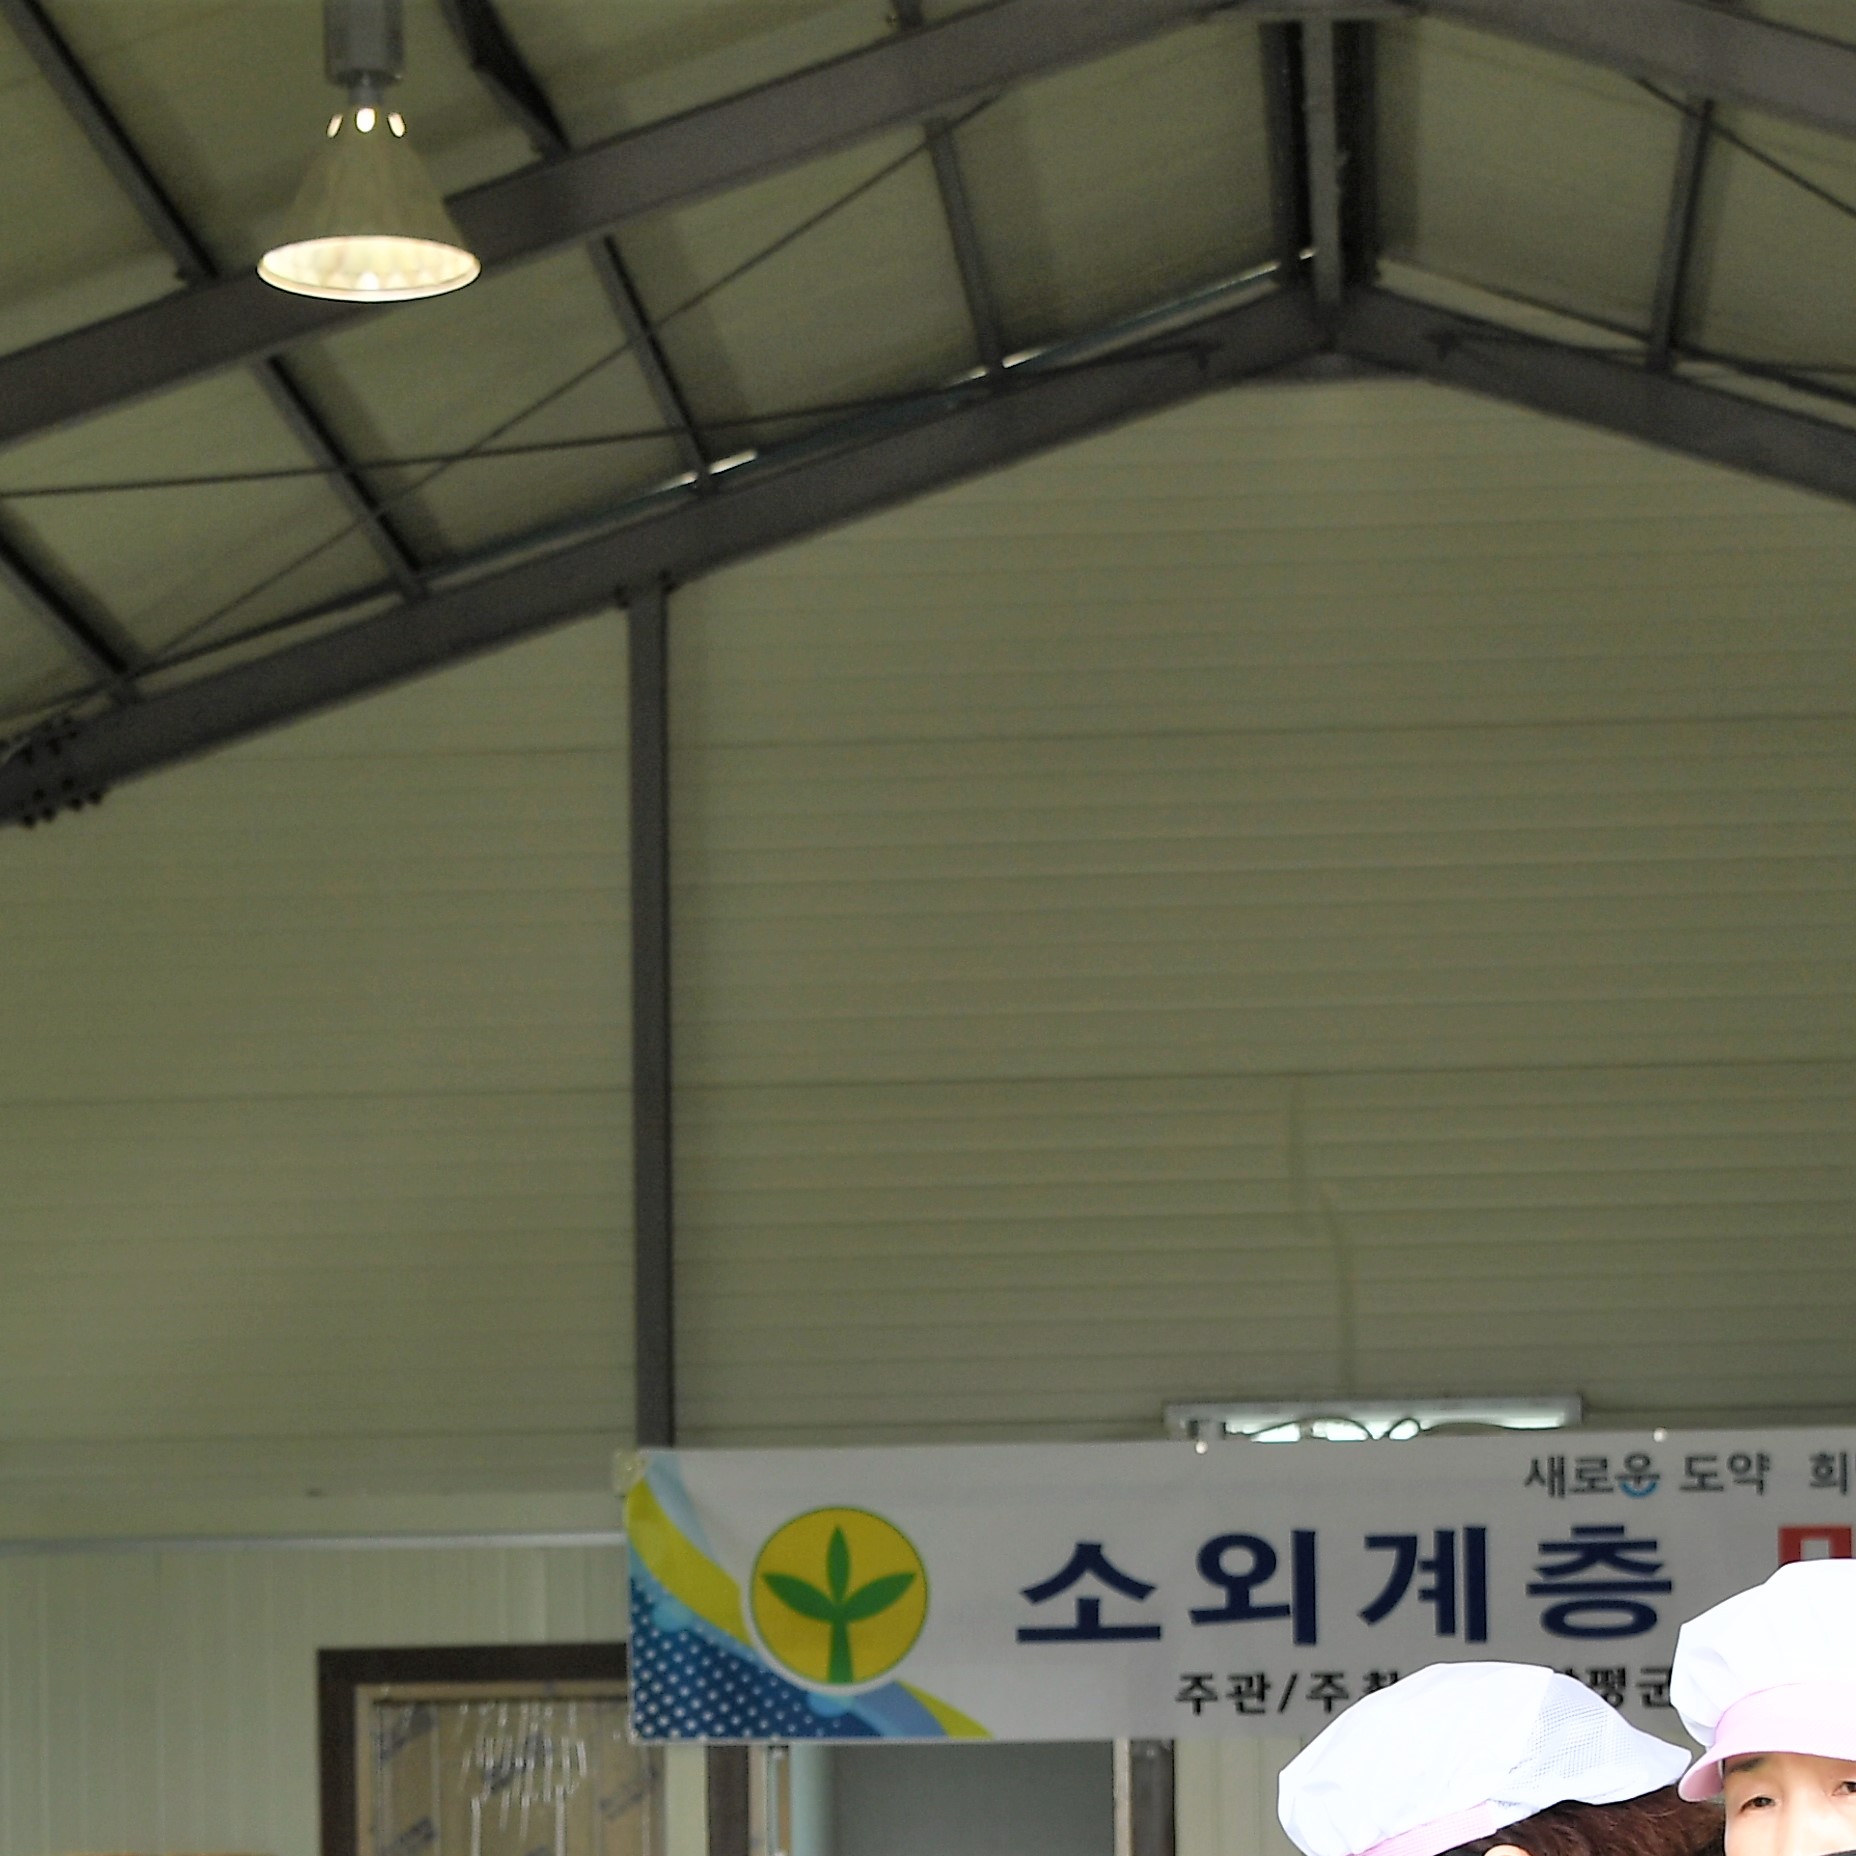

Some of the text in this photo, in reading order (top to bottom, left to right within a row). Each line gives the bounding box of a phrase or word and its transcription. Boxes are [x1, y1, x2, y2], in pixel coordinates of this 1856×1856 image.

[1524, 1450, 1658, 1498] 새로운
[1679, 1452, 1771, 1495] 도약
[1015, 1524, 1673, 1646] 소외계층
